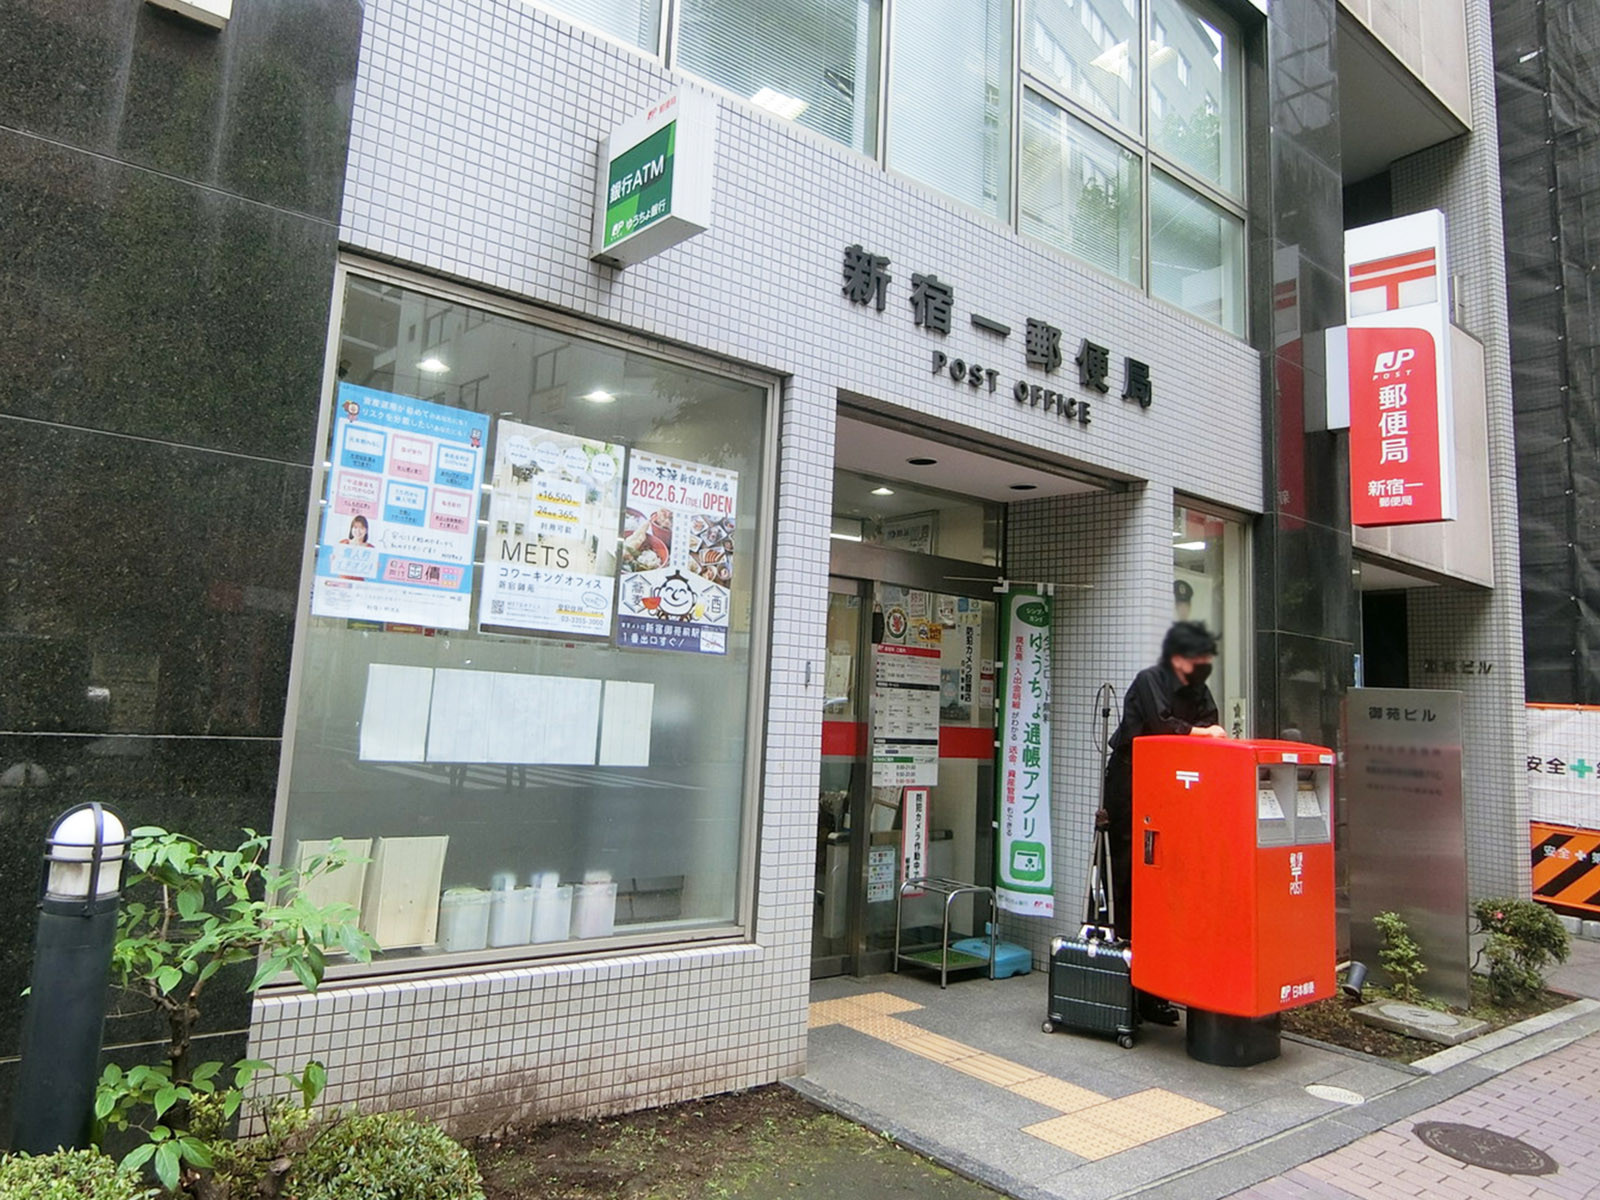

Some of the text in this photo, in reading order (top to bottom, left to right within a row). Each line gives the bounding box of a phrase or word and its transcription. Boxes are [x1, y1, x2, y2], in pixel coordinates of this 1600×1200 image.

[609, 155, 665, 204] 銀行ATM
[626, 199, 667, 231] ゆうちょ銀行
[842, 243, 1152, 409] 新宿一郵便局
[932, 350, 1092, 425] POST OFFICE
[1372, 368, 1413, 382] POST
[1378, 382, 1409, 466] 郵便局
[702, 491, 734, 514] OPEN
[1367, 478, 1424, 498] 新宿一
[1378, 495, 1414, 508] 郵便局
[501, 539, 570, 569] METS
[499, 567, 602, 590] コワーキングオフィス
[1368, 705, 1437, 723] 御苑ビル
[1023, 632, 1044, 839] ゆうちょ通帳アプリ
